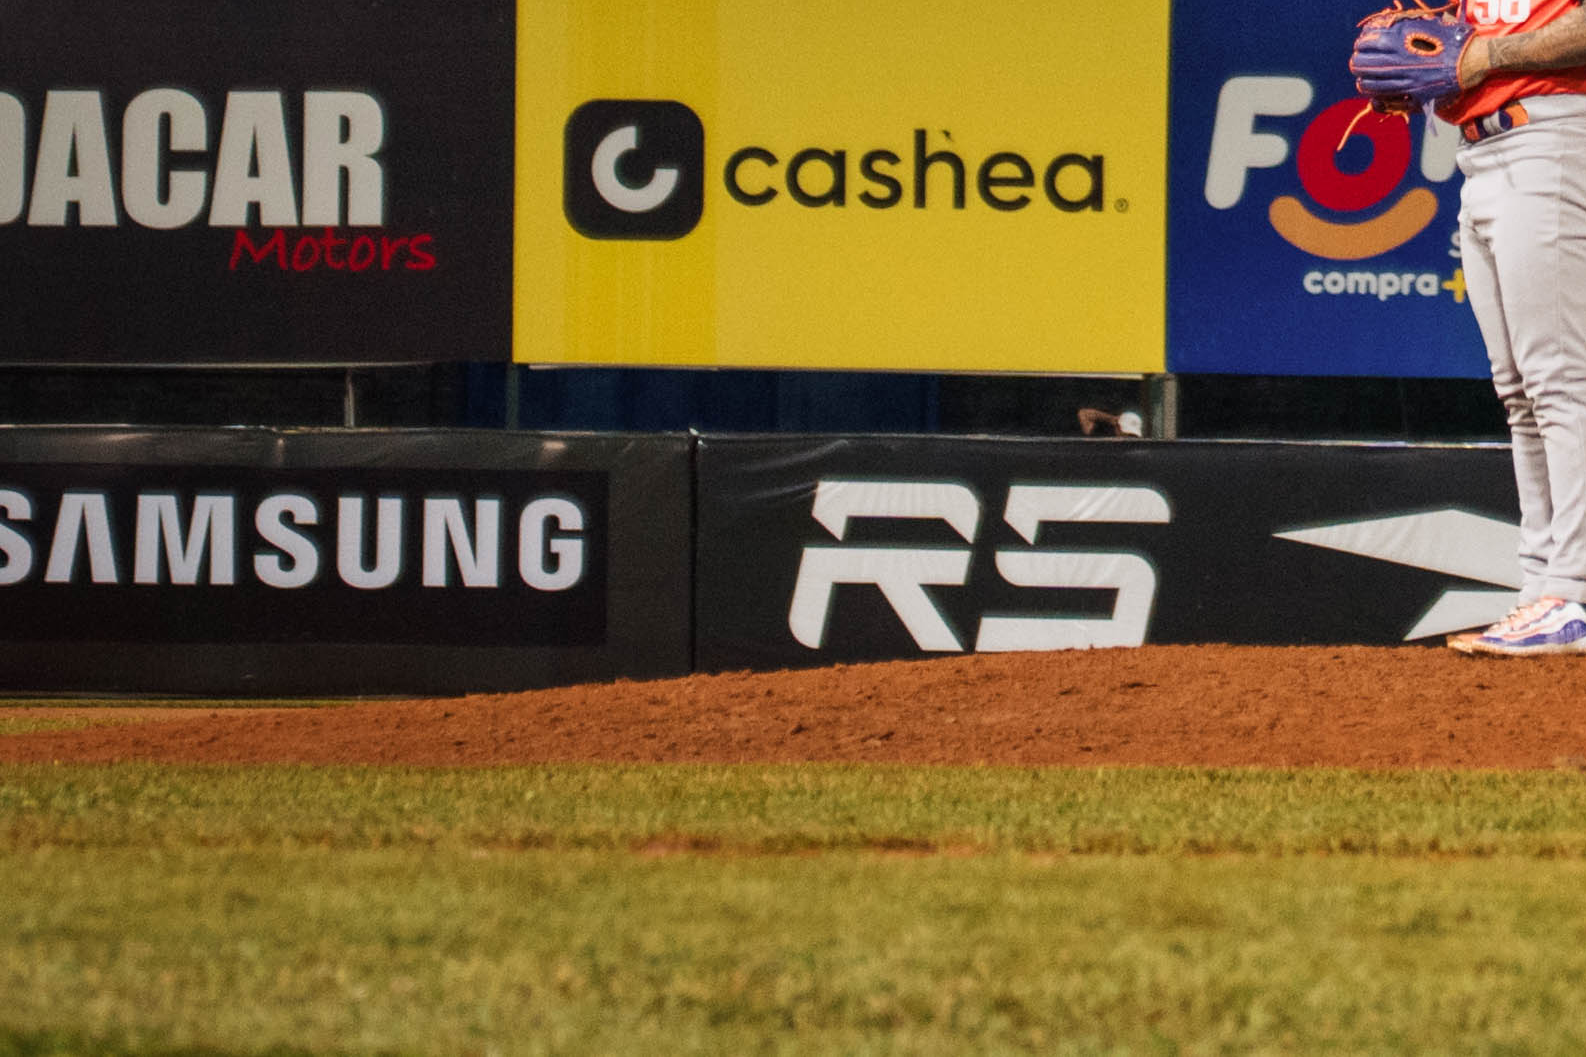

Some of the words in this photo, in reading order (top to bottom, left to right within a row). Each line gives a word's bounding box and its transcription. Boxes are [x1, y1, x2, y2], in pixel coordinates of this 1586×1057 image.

[0, 87, 385, 229] ACAR
[723, 128, 1106, 213] cashea
[228, 228, 436, 272] Motors
